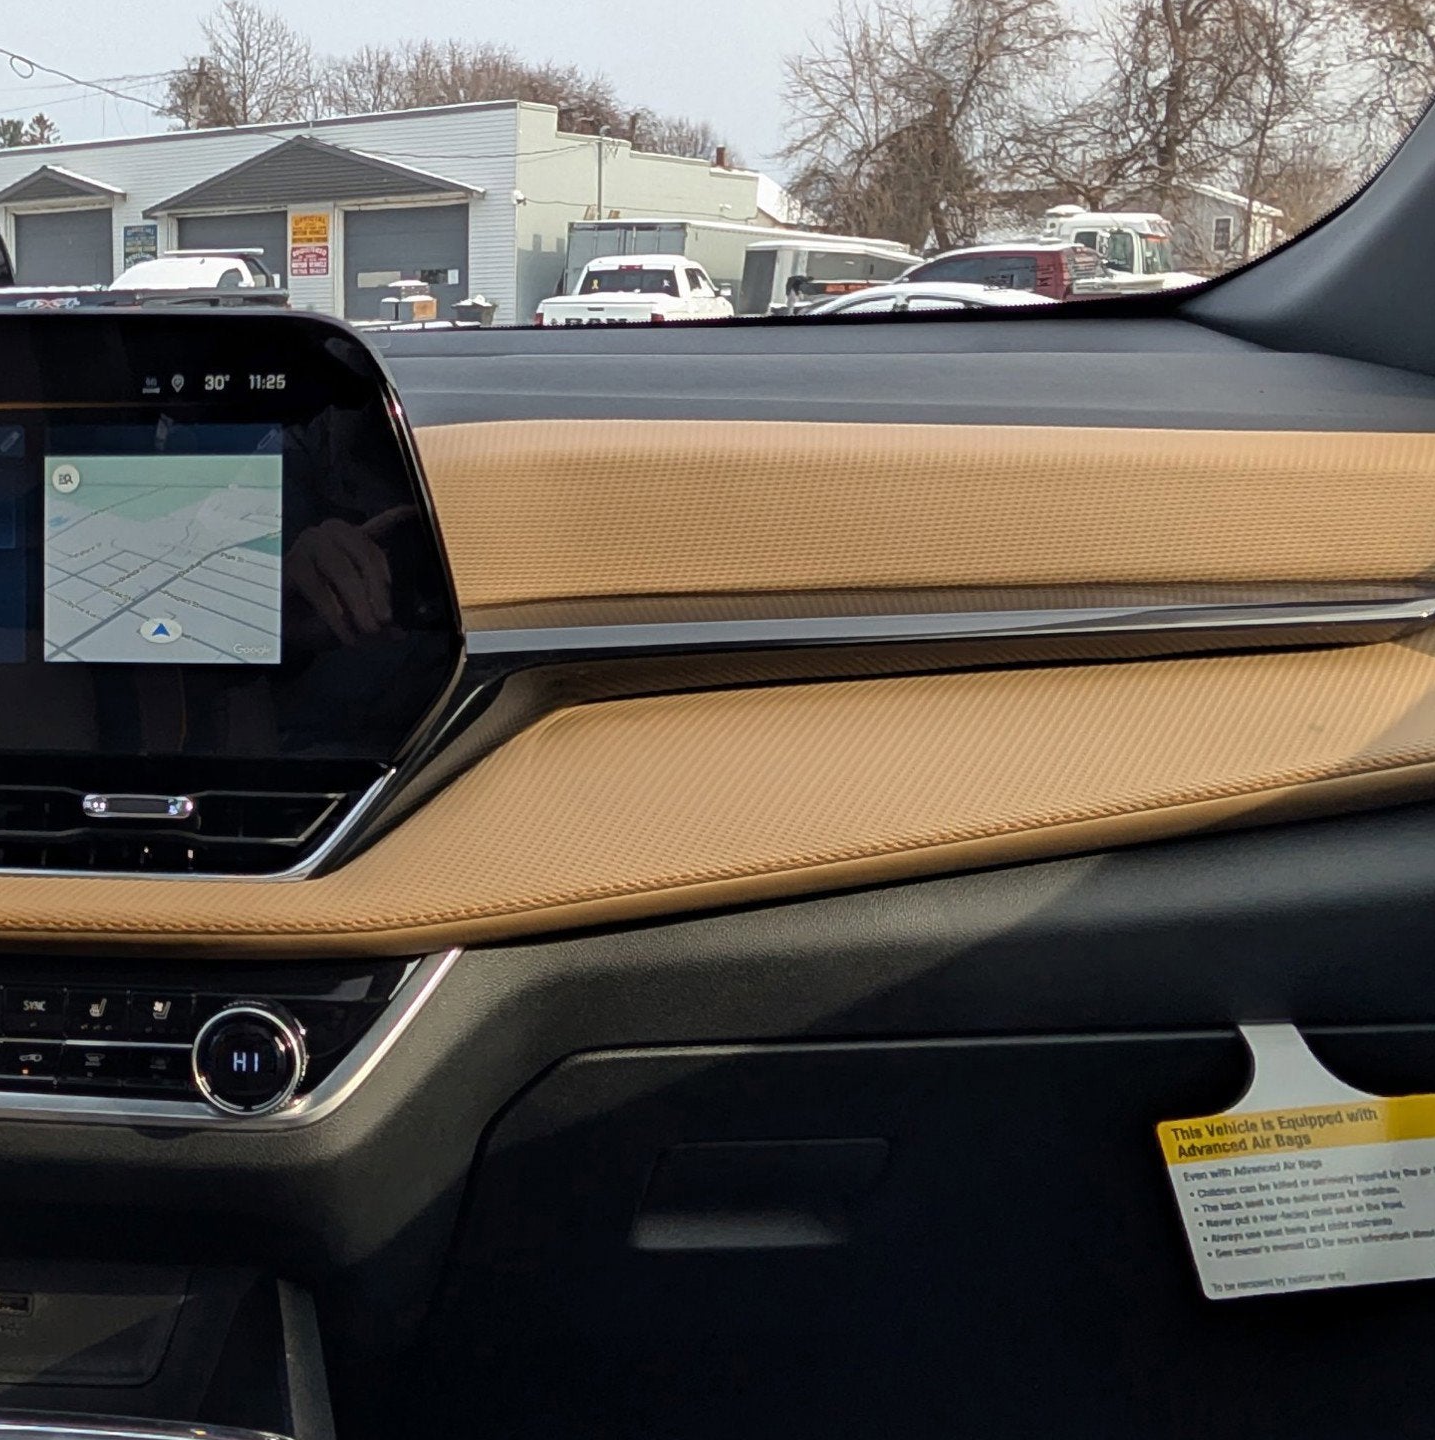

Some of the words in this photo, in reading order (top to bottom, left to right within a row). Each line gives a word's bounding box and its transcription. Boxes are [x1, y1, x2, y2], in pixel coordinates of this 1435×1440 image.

[204, 374, 231, 390] 30°
[249, 374, 286, 390] 11:25
[232, 642, 272, 656] Google
[23, 1000, 46, 1011] SYNC
[232, 1051, 260, 1072] HI
[1172, 1127, 1203, 1142] This
[1205, 1120, 1259, 1138] Vehicle
[1262, 1117, 1275, 1131] is
[1277, 1111, 1344, 1131] Equipped
[1347, 1107, 1380, 1122] with
[1178, 1138, 1248, 1158] Advanced
[1252, 1136, 1271, 1150] Air
[1275, 1133, 1312, 1149] Bags
[1184, 1169, 1207, 1182] Even
[1233, 1162, 1281, 1177] Advanced
[1298, 1159, 1322, 1171] Bags
